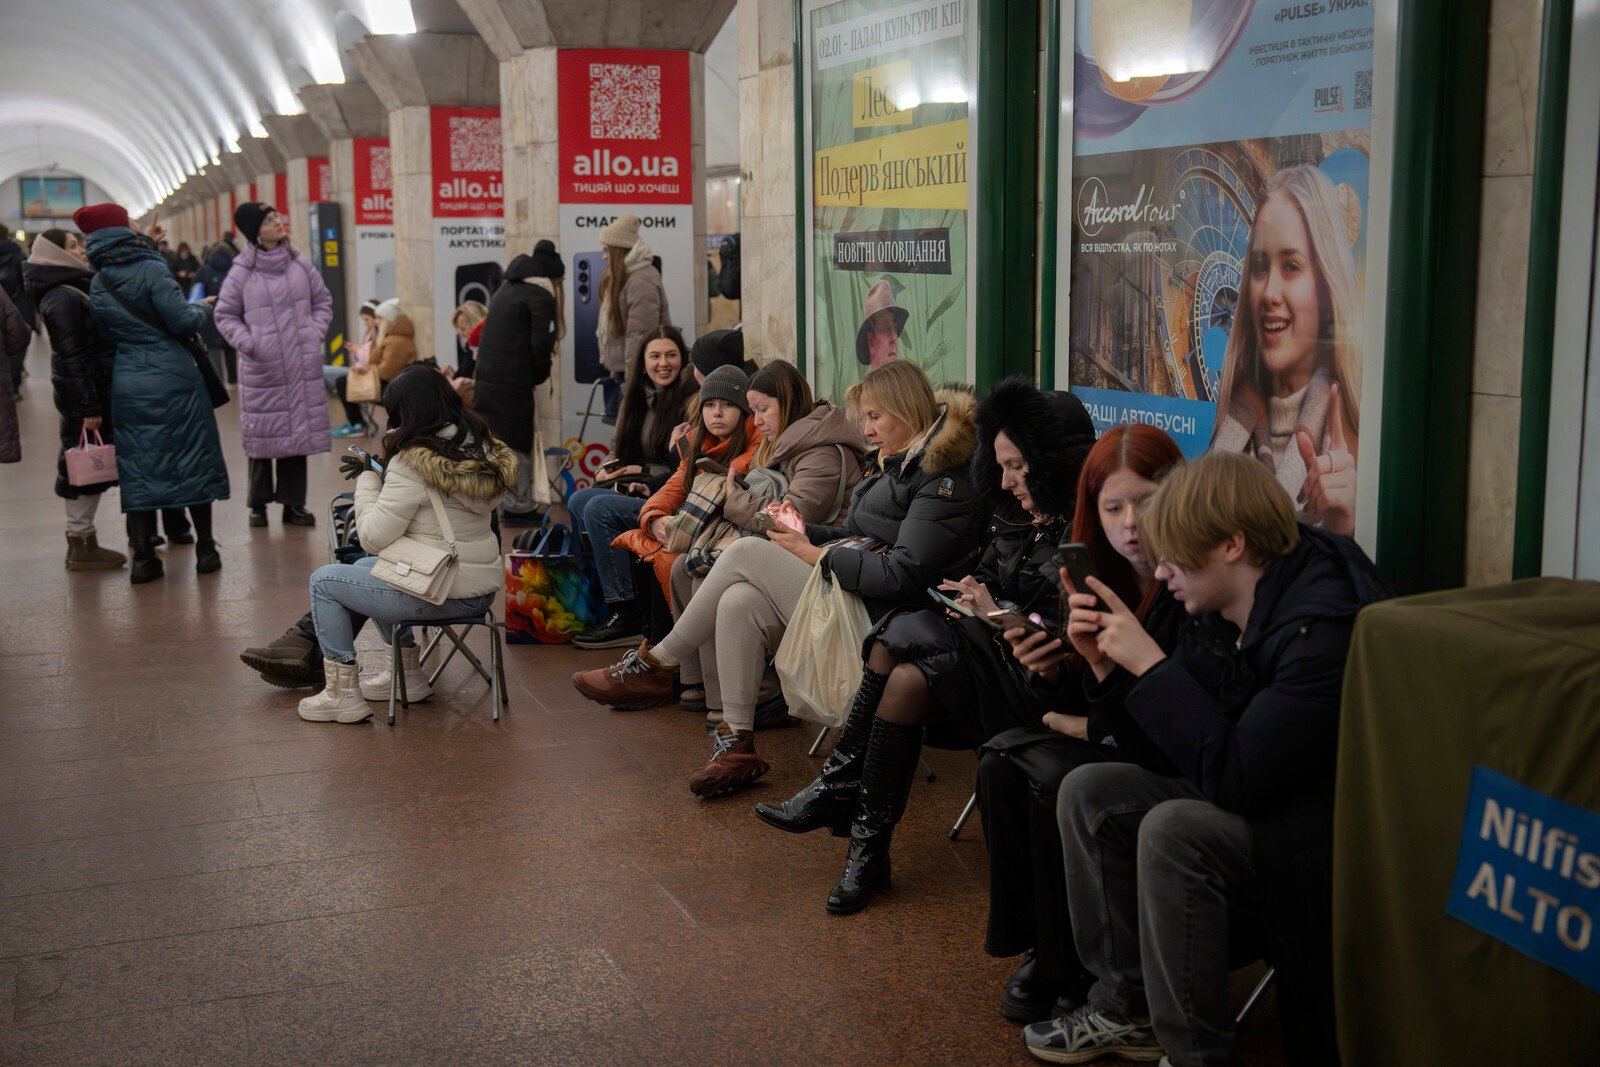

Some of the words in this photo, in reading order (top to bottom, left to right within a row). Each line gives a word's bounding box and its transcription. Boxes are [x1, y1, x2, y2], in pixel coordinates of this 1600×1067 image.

[1273, 2, 1326, 22] «PULSE»
[818, 34, 842, 60] 02.01
[850, 23, 882, 51] ПАЛАЦ
[884, 7, 938, 43] КУЛЬТУРИ
[1256, 51, 1299, 67] ПОРЯТУНОК
[1314, 86, 1340, 107] PULSE
[572, 149, 679, 176] allo.ua
[820, 142, 968, 206] Подерв'янський
[573, 182, 612, 194] ТИЦЯЙ
[614, 184, 636, 194] ЩО
[638, 183, 680, 194] ХОЧЕШ
[837, 241, 875, 263] НОВІТНІ
[877, 239, 947, 266] ОПОВІДАННЯ
[1080, 243, 1093, 253] ВСЯ
[1094, 243, 1132, 254] ВІДПУСТКА,
[1132, 243, 1142, 253] ЯК
[1143, 242, 1154, 253] ПО
[1154, 242, 1177, 253] НОТАХ
[1119, 407, 1196, 436] АВТОБУСНІ
[1479, 798, 1600, 889] Nilfis
[1466, 861, 1593, 952] ALTO
